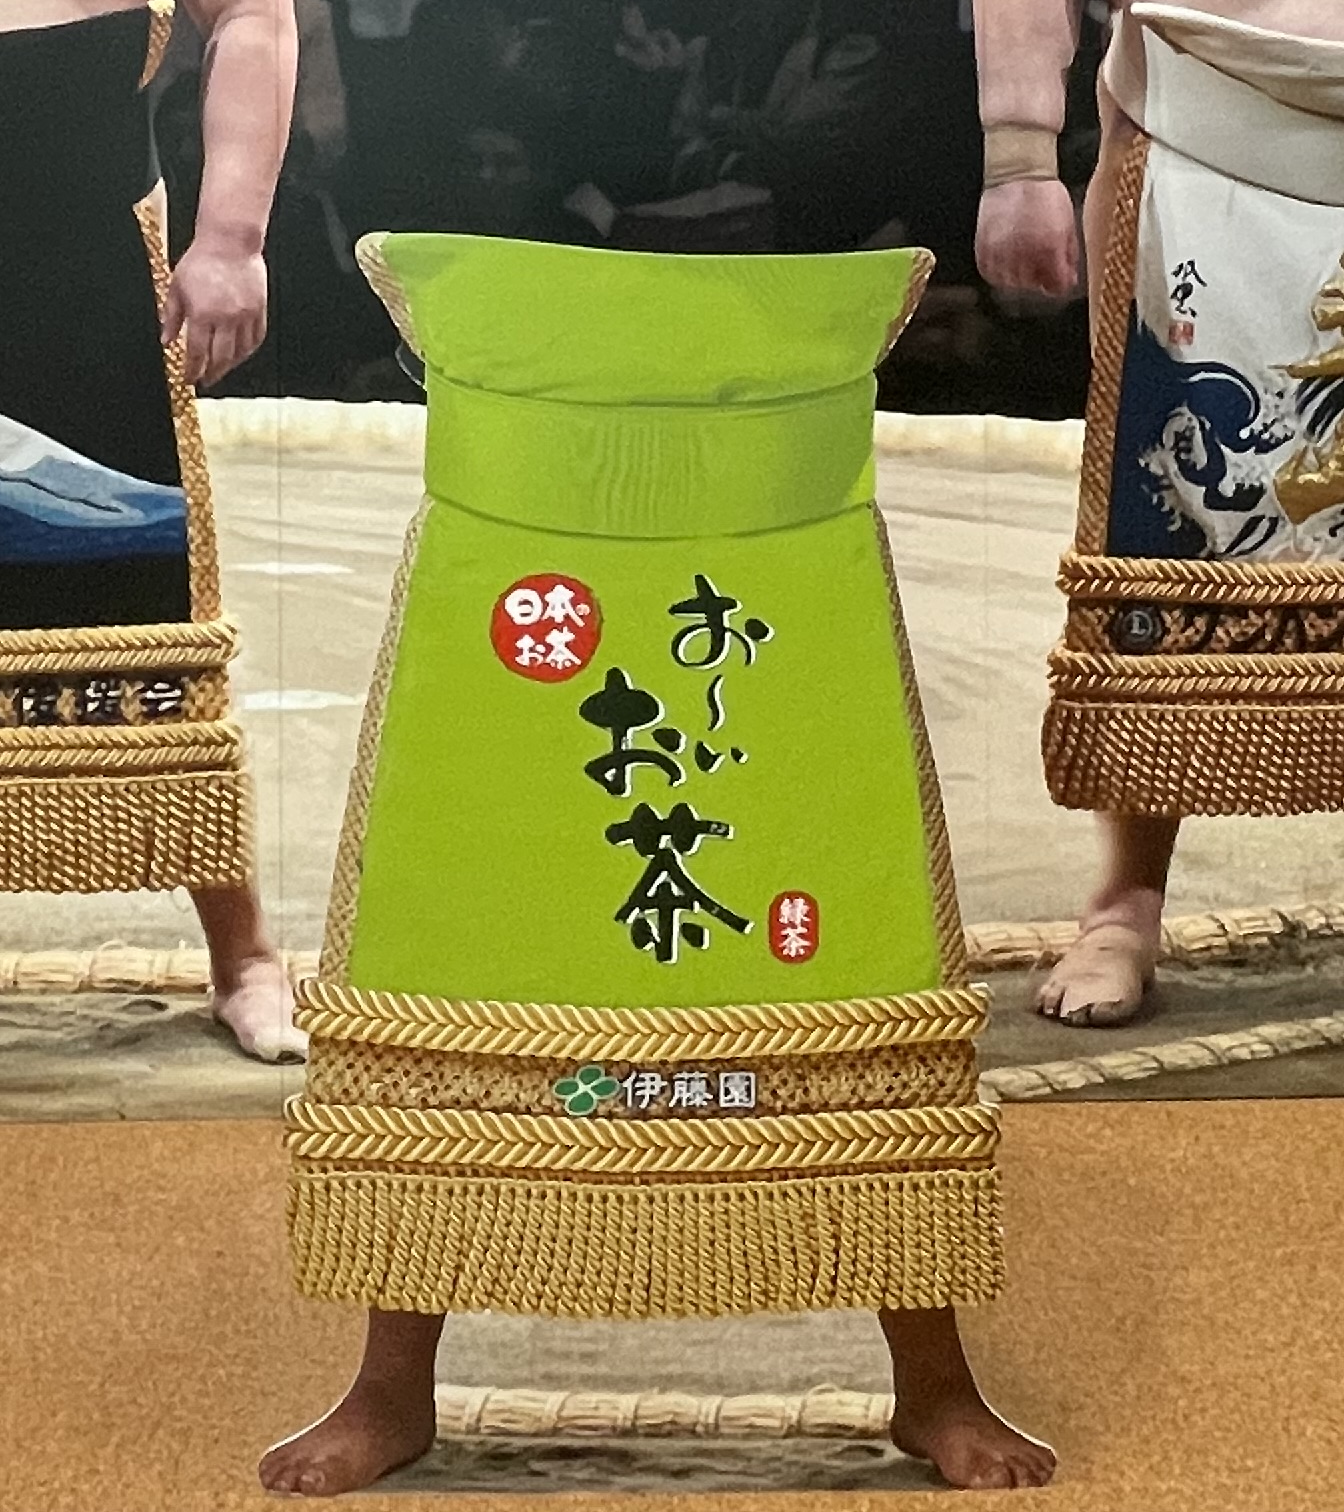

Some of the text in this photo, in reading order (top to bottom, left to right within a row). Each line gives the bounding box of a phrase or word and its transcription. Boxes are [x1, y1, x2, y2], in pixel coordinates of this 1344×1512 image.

[515, 626, 582, 671] お茶
[622, 1069, 757, 1110] 伊藤園
